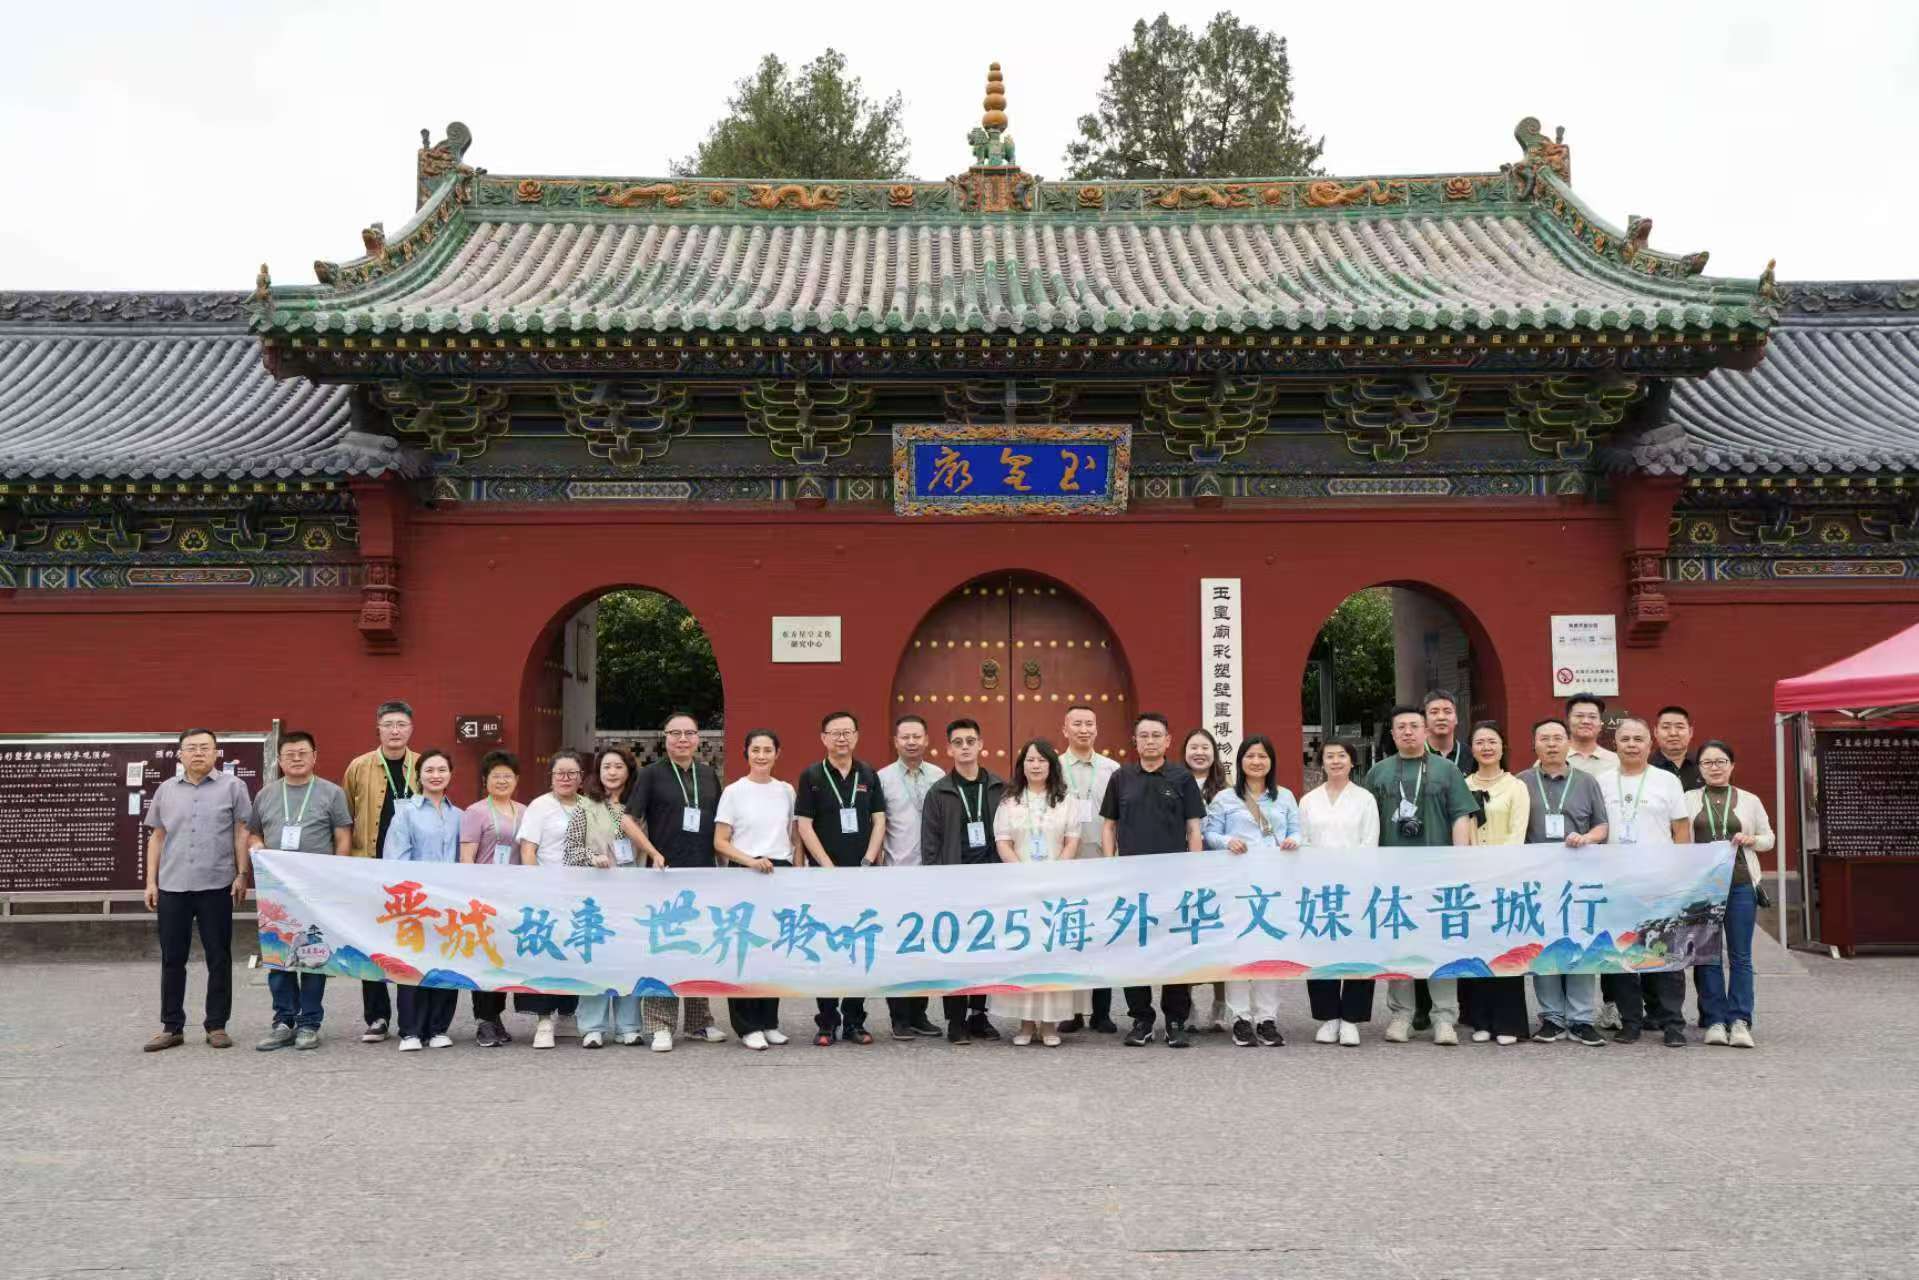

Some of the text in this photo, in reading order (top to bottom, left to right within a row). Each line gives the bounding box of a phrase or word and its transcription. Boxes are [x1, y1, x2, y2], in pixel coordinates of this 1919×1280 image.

[483, 723, 498, 731] 出口
[376, 880, 1609, 978] 晋城故事 世界聆听 2025海外华文媒体晋城行
